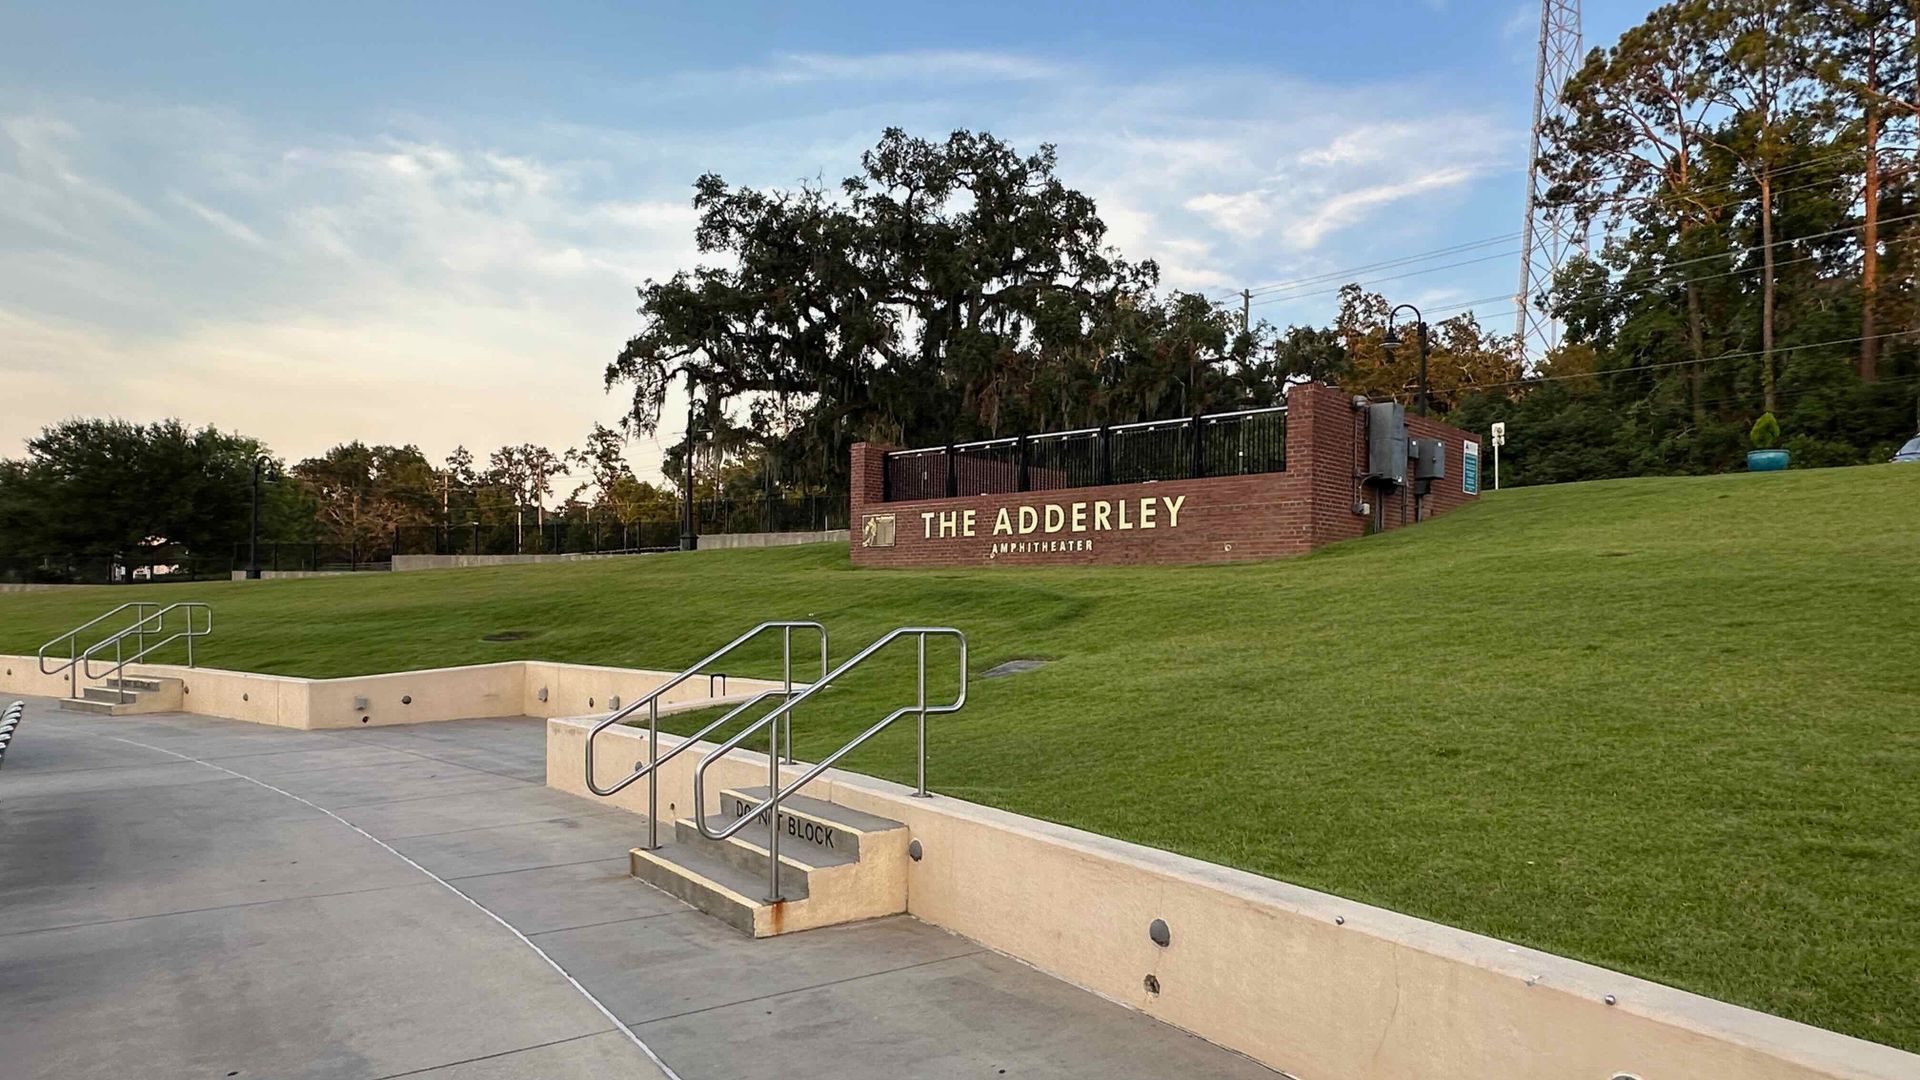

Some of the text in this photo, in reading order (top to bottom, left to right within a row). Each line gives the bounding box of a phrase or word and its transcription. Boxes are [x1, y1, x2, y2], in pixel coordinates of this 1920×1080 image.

[921, 495, 1186, 539] THE ADDERLEY
[992, 539, 1093, 554] AMPHITHEATER
[788, 815, 834, 849] BLOCK
